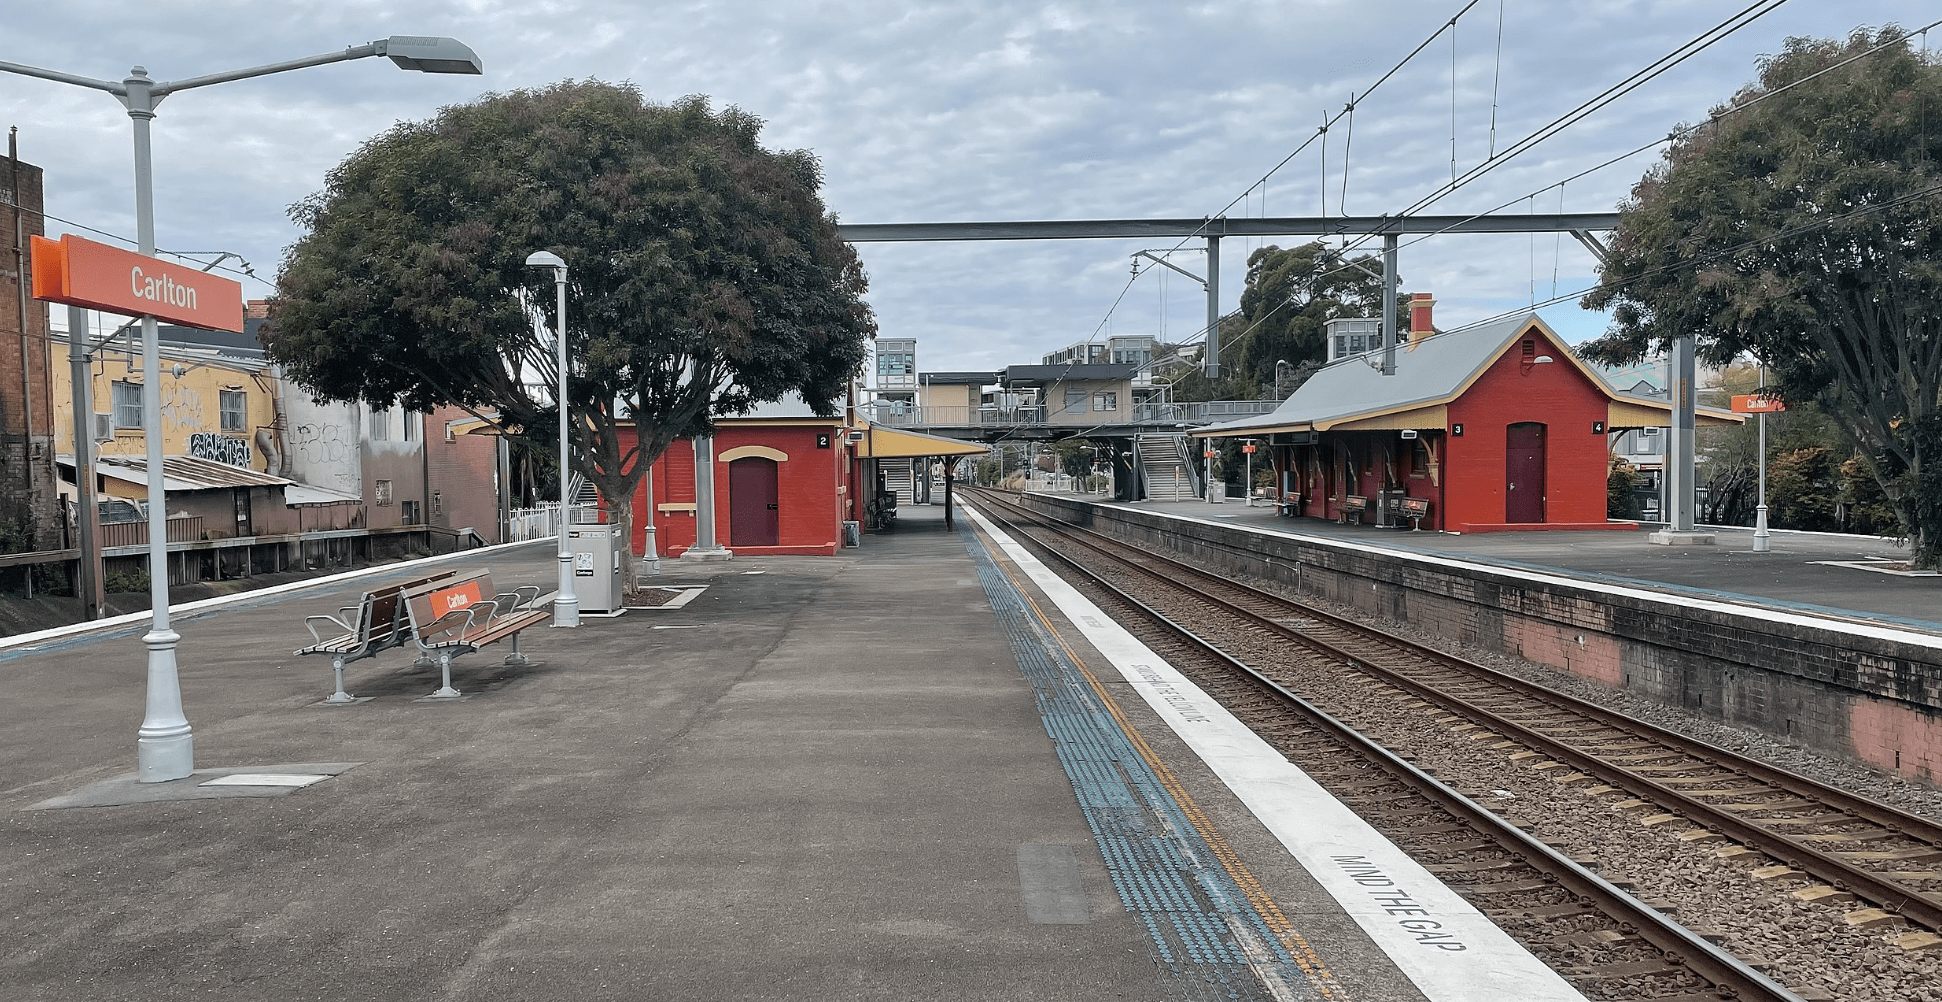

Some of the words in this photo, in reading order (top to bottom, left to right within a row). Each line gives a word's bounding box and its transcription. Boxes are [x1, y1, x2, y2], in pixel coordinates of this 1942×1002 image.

[131, 266, 197, 309] Carlton
[1455, 425, 1461, 433] 3
[1595, 423, 1601, 432] 4
[820, 437, 826, 446] 2
[446, 593, 468, 608] Carlton
[1330, 855, 1395, 887] MIND
[1368, 888, 1430, 916] THE
[1398, 919, 1467, 952] GAP
